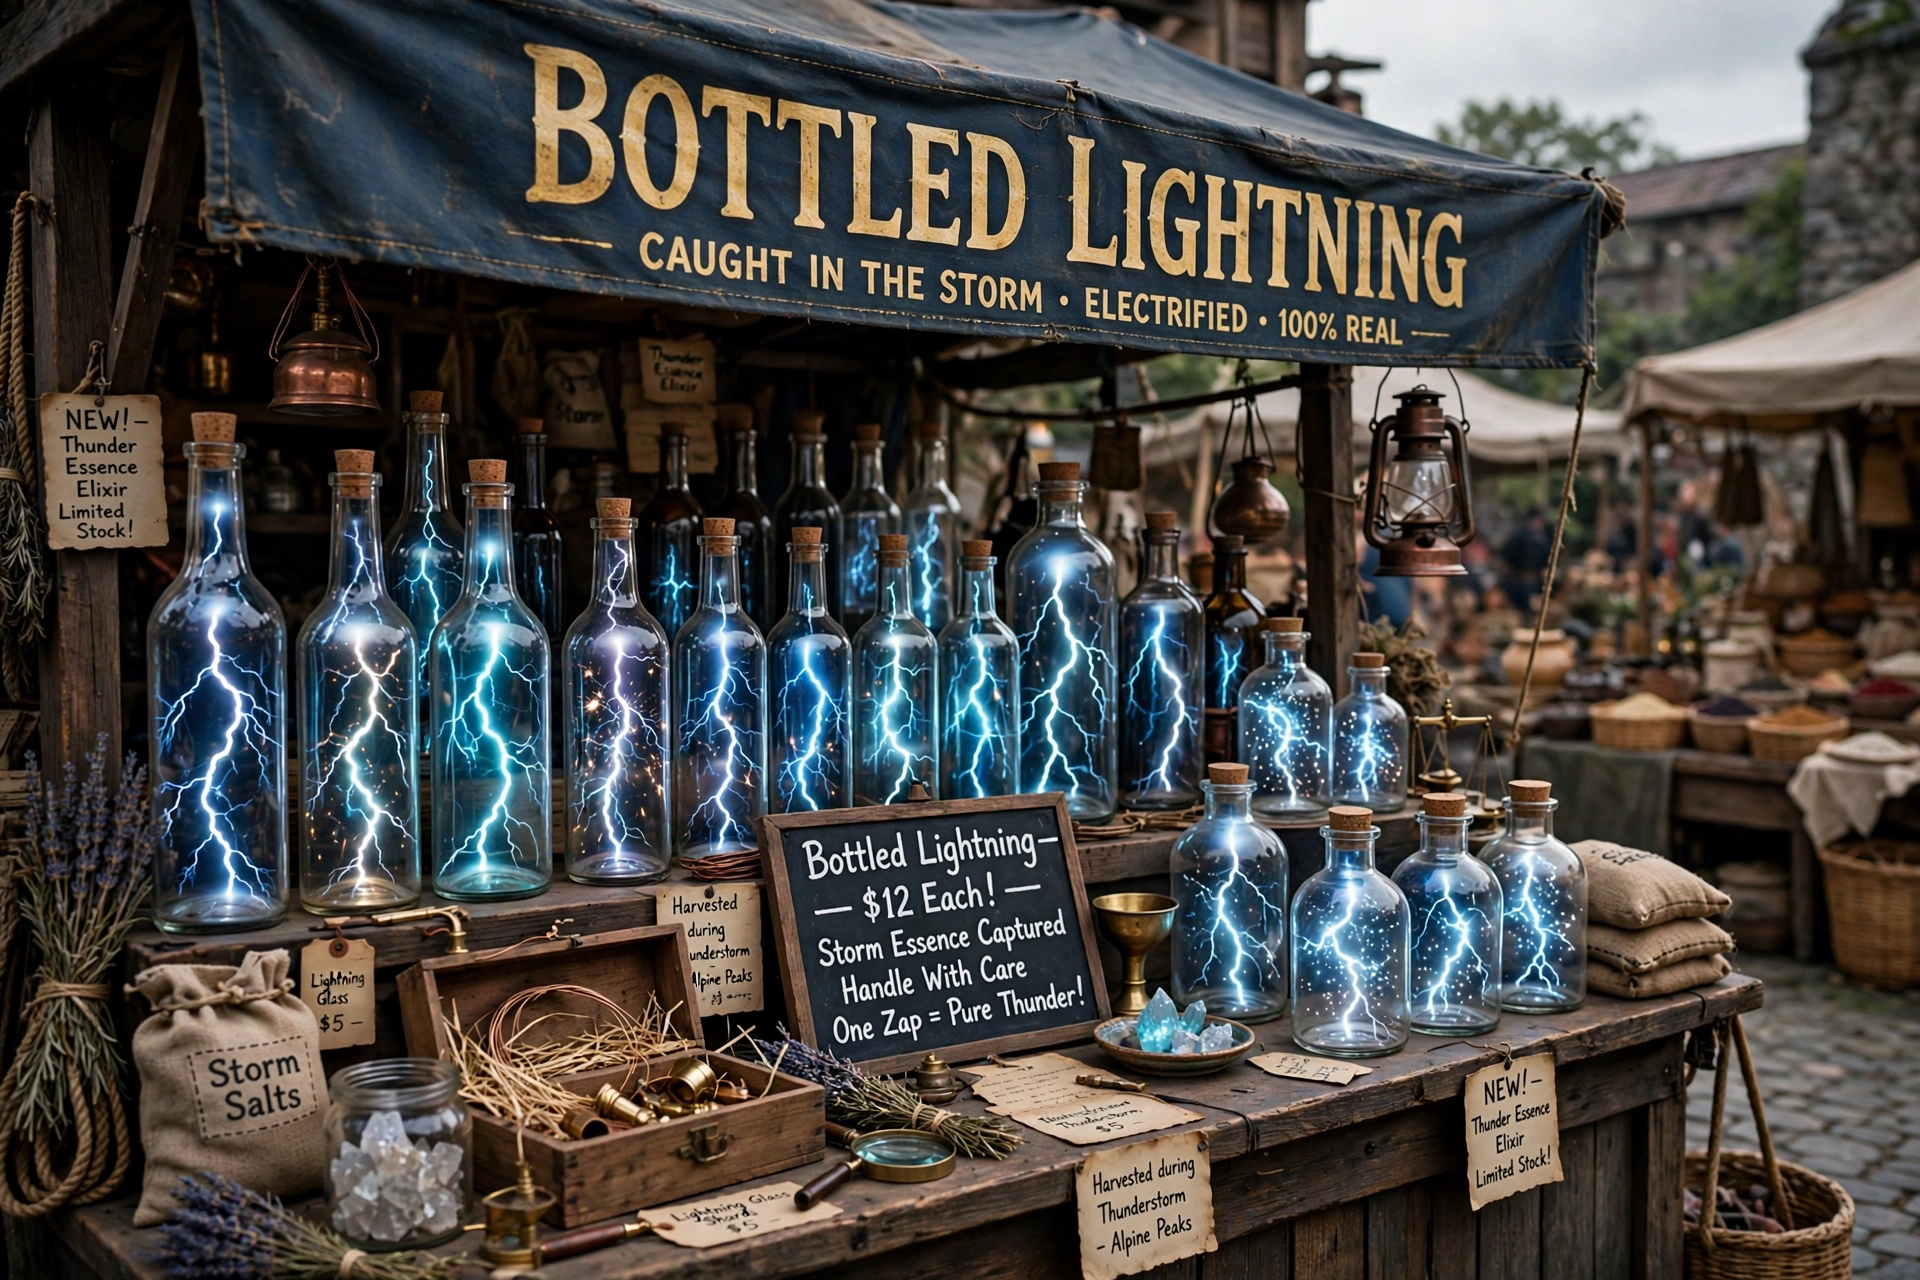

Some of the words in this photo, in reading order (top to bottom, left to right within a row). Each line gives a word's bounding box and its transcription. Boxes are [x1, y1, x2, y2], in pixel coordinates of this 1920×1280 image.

[523, 42, 1027, 252] BOTTLED
[1066, 134, 1467, 310] LIGHTNING
[639, 231, 793, 285] CAUGHT
[810, 254, 844, 292] IN
[861, 260, 924, 301] THE
[939, 269, 1043, 315] STORM
[1085, 287, 1248, 334] ELECTRIFIED
[1278, 307, 1338, 342] 100%
[1346, 313, 1403, 346] REAL
[60, 435, 137, 453] Thunder
[66, 457, 138, 475] Essence
[77, 479, 128, 498] Elixir
[59, 501, 125, 520] Limited
[76, 518, 133, 540] Stock!
[801, 831, 908, 880] Bottled
[672, 892, 738, 915] Harvested
[861, 884, 914, 924] $12
[921, 871, 996, 915] Each!
[687, 920, 726, 943] during
[817, 937, 884, 968] Storm
[890, 928, 971, 958] Essence
[976, 908, 1067, 952] Captured
[311, 970, 365, 991] Lightning
[725, 968, 753, 985] Peaks
[840, 967, 915, 1005] Handle
[921, 958, 973, 992] With
[979, 954, 1027, 984] Care
[832, 1015, 875, 1045] One
[880, 1008, 923, 1042] Zap
[946, 996, 993, 1027] Pure
[996, 974, 1086, 1018] Thunder!
[208, 1054, 301, 1088] Storm
[224, 1083, 302, 1121] Salts
[1471, 1109, 1512, 1136] Thunder
[1515, 1102, 1551, 1123] Essence
[1495, 1132, 1525, 1154] Elixir
[1093, 1161, 1153, 1196] Harvested
[1158, 1157, 1196, 1180] during
[1476, 1158, 1515, 1189] Limited
[1518, 1144, 1551, 1174] Stock!
[748, 1192, 791, 1204] Glass
[1097, 1190, 1186, 1225] Thunderstorm
[1110, 1229, 1151, 1258] Alpine
[1156, 1214, 1193, 1240] Peaks
